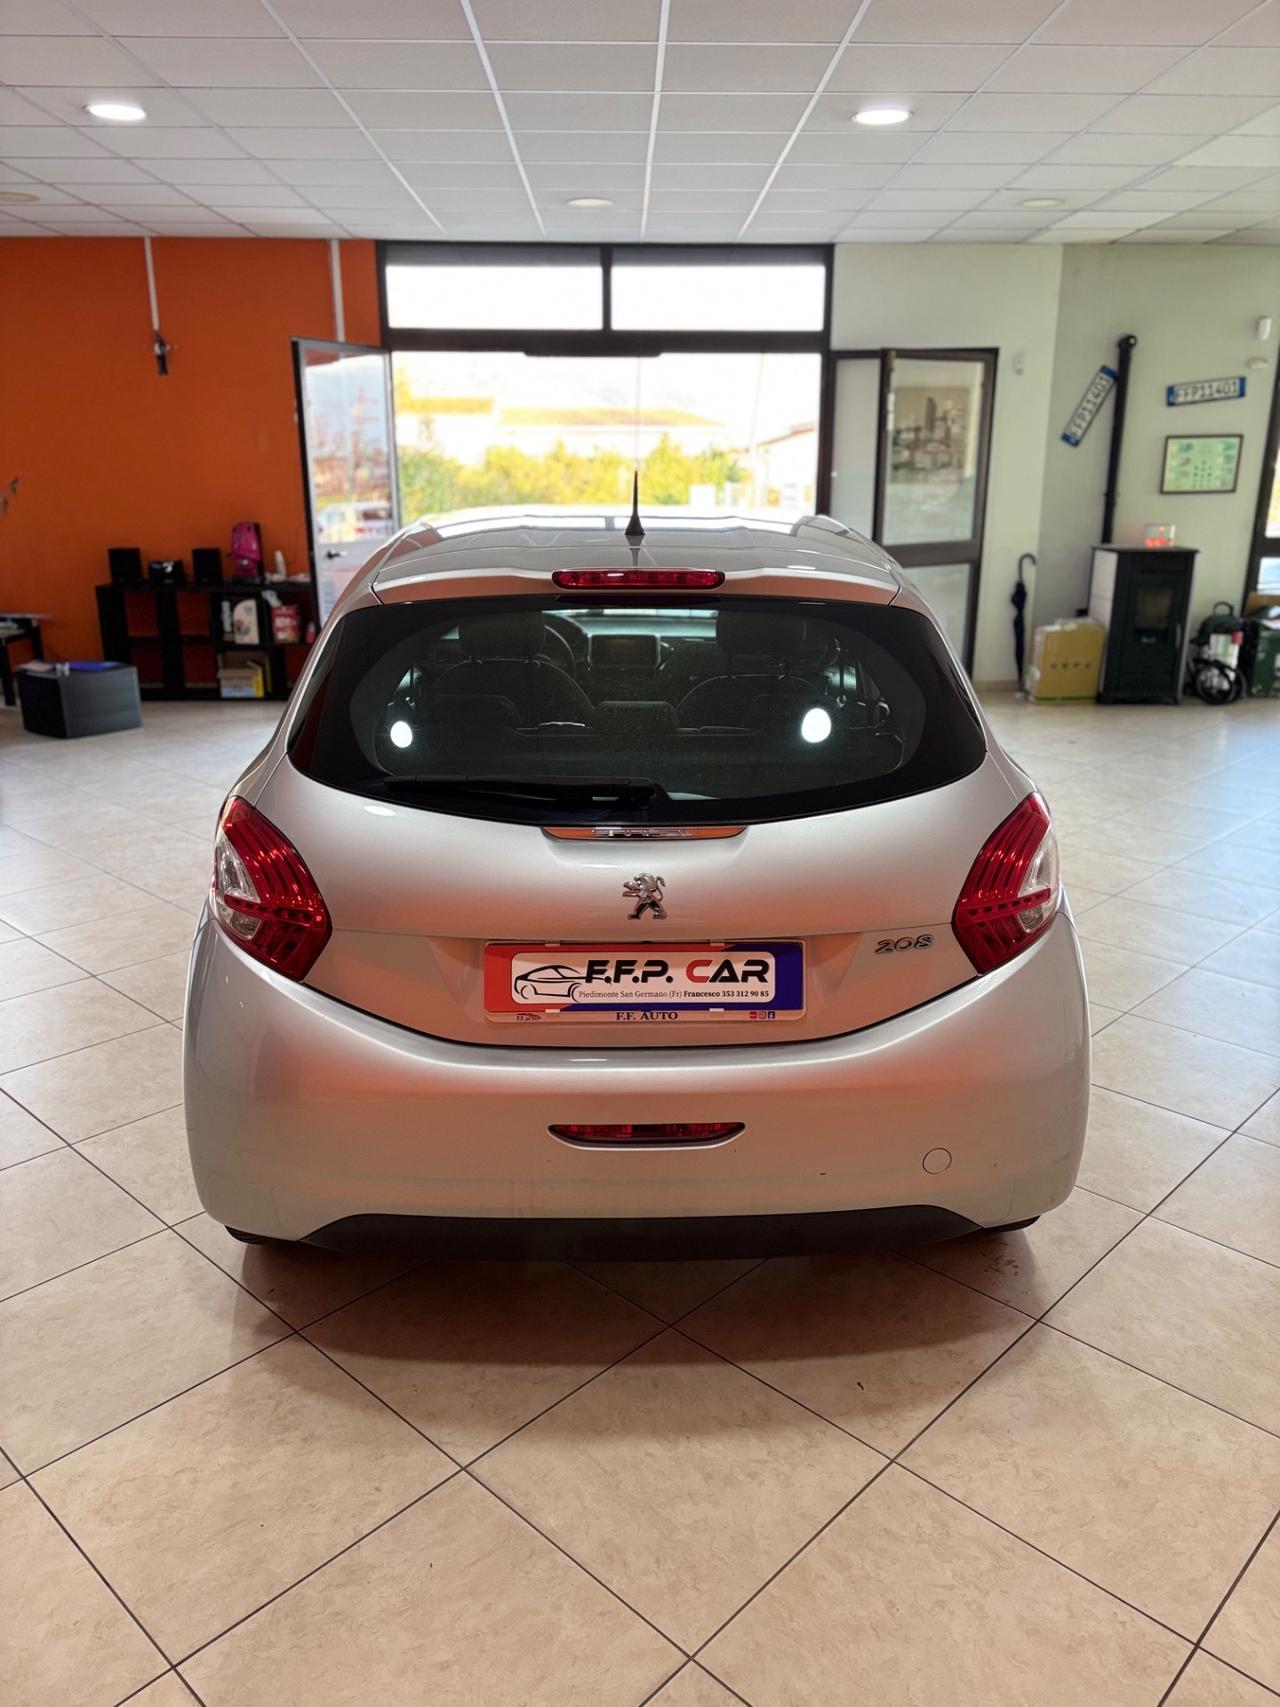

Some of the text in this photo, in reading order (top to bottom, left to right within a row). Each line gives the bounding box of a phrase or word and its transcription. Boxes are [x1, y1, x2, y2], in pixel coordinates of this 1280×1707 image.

[875, 933, 934, 955] 208
[585, 959, 770, 984] F.F.P. CAR
[578, 990, 769, 999] Piedimonte San Germano (Fr) Francesco 353 312 90 85
[616, 1012, 678, 1020] F.F. AUTO
